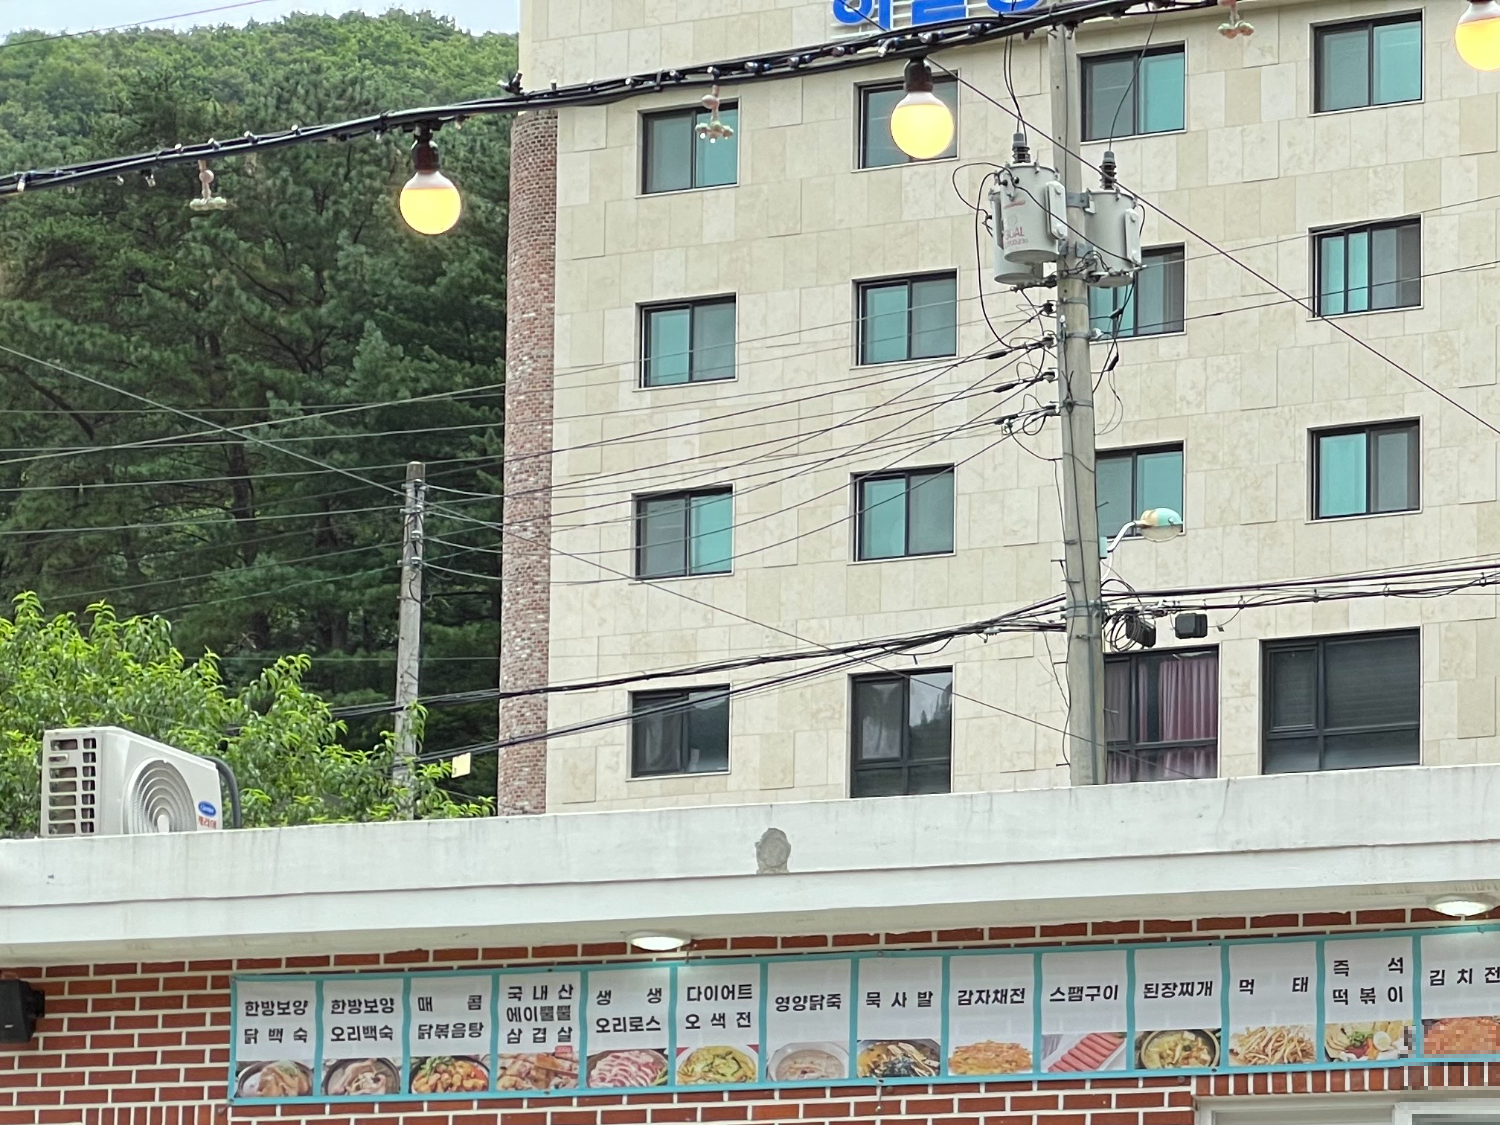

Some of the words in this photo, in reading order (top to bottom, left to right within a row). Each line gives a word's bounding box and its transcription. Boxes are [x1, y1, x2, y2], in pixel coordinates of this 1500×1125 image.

[1333, 956, 1404, 977] 즉석
[1239, 976, 1309, 995] 먹태
[1429, 966, 1500, 987] 김치전
[507, 983, 574, 1002] 국내산
[596, 987, 662, 1006] 생생
[687, 983, 753, 1002] 다이어트
[957, 987, 1026, 1006] 감자채전
[1049, 984, 1119, 1002] 스팸구이
[1143, 980, 1213, 999] 된장찌개
[1332, 985, 1403, 1006] 떡볶이
[244, 1000, 309, 1017] 한방보양
[330, 997, 395, 1015] 한방보양
[417, 994, 482, 1012] 매콤
[775, 993, 842, 1012] 영양닭죽
[865, 990, 934, 1009] 묵사발
[596, 1015, 662, 1034] 오리로스
[685, 1011, 751, 1030] 오색전
[244, 1027, 308, 1045] 닭백숙
[330, 1024, 394, 1042] 오리백숙
[417, 1021, 485, 1040] 닭볶음탕
[507, 1026, 573, 1045] 삼겹살
